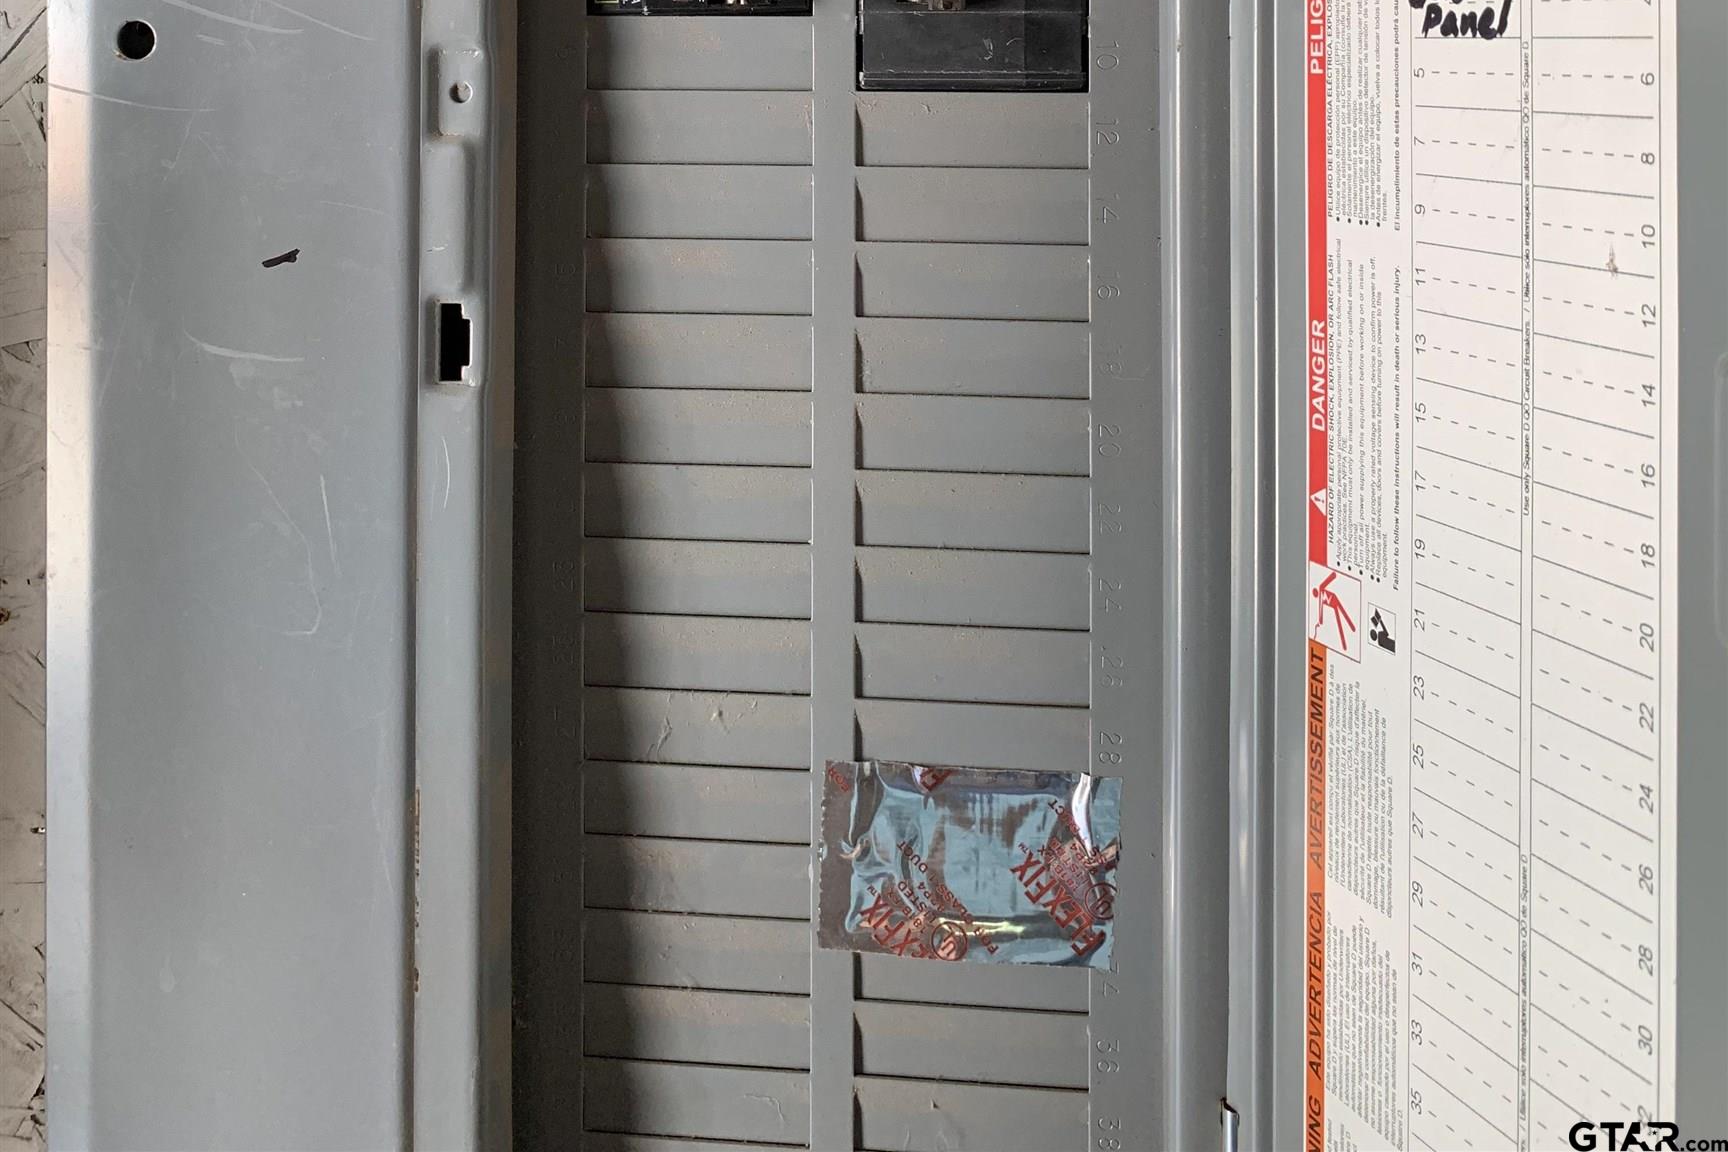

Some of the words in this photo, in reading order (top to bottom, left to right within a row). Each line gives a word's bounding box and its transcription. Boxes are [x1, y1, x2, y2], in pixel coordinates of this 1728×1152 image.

[1096, 41, 1119, 70] 10
[1414, 68, 1424, 78] 5
[1641, 73, 1654, 86] 6
[1097, 118, 1120, 145] 12
[1414, 136, 1425, 146] 7
[1327, 158, 1334, 171] DE
[1641, 152, 1655, 165] 8
[1414, 204, 1425, 214] 9
[1641, 224, 1655, 248] 10
[1415, 268, 1426, 286] 11
[1328, 313, 1334, 329] OR
[1642, 304, 1656, 327] 12
[1393, 332, 1400, 344] or
[1415, 334, 1426, 354] 13
[1312, 319, 1325, 432] DANGER
[1393, 373, 1400, 383] in
[1642, 384, 1656, 406] 14
[1415, 402, 1426, 422] 15
[1099, 423, 1121, 458] 20
[1415, 470, 1426, 491] 17
[1641, 464, 1655, 487] 16
[1328, 485, 1334, 500] OF
[1100, 503, 1122, 536] 22
[1393, 546, 1400, 557] to
[1414, 539, 1425, 559] 19
[1641, 544, 1655, 568] 18
[1100, 578, 1122, 616] 24
[1414, 609, 1424, 631] 21
[1640, 623, 1654, 652] 20
[1413, 676, 1424, 700] 23
[1639, 702, 1654, 733] 22
[1100, 729, 1122, 765] 28
[1311, 647, 1323, 870] AVERTISSEMENT
[1413, 744, 1424, 769] 25
[1639, 784, 1653, 814] 24
[1412, 812, 1423, 838] 27
[896, 840, 930, 874] DUCT
[1639, 864, 1653, 895] 26
[896, 880, 937, 923] LISTED
[1412, 881, 1423, 907] 29
[1412, 952, 1422, 976] 31
[1638, 945, 1653, 976] 28
[1309, 891, 1321, 1081] ADVERTENCIA
[1411, 1020, 1422, 1045] 33
[1638, 1025, 1652, 1056] 30
[1097, 1040, 1120, 1073] 36
[1411, 1088, 1422, 1115] 35
[1098, 1117, 1121, 1151] 38
